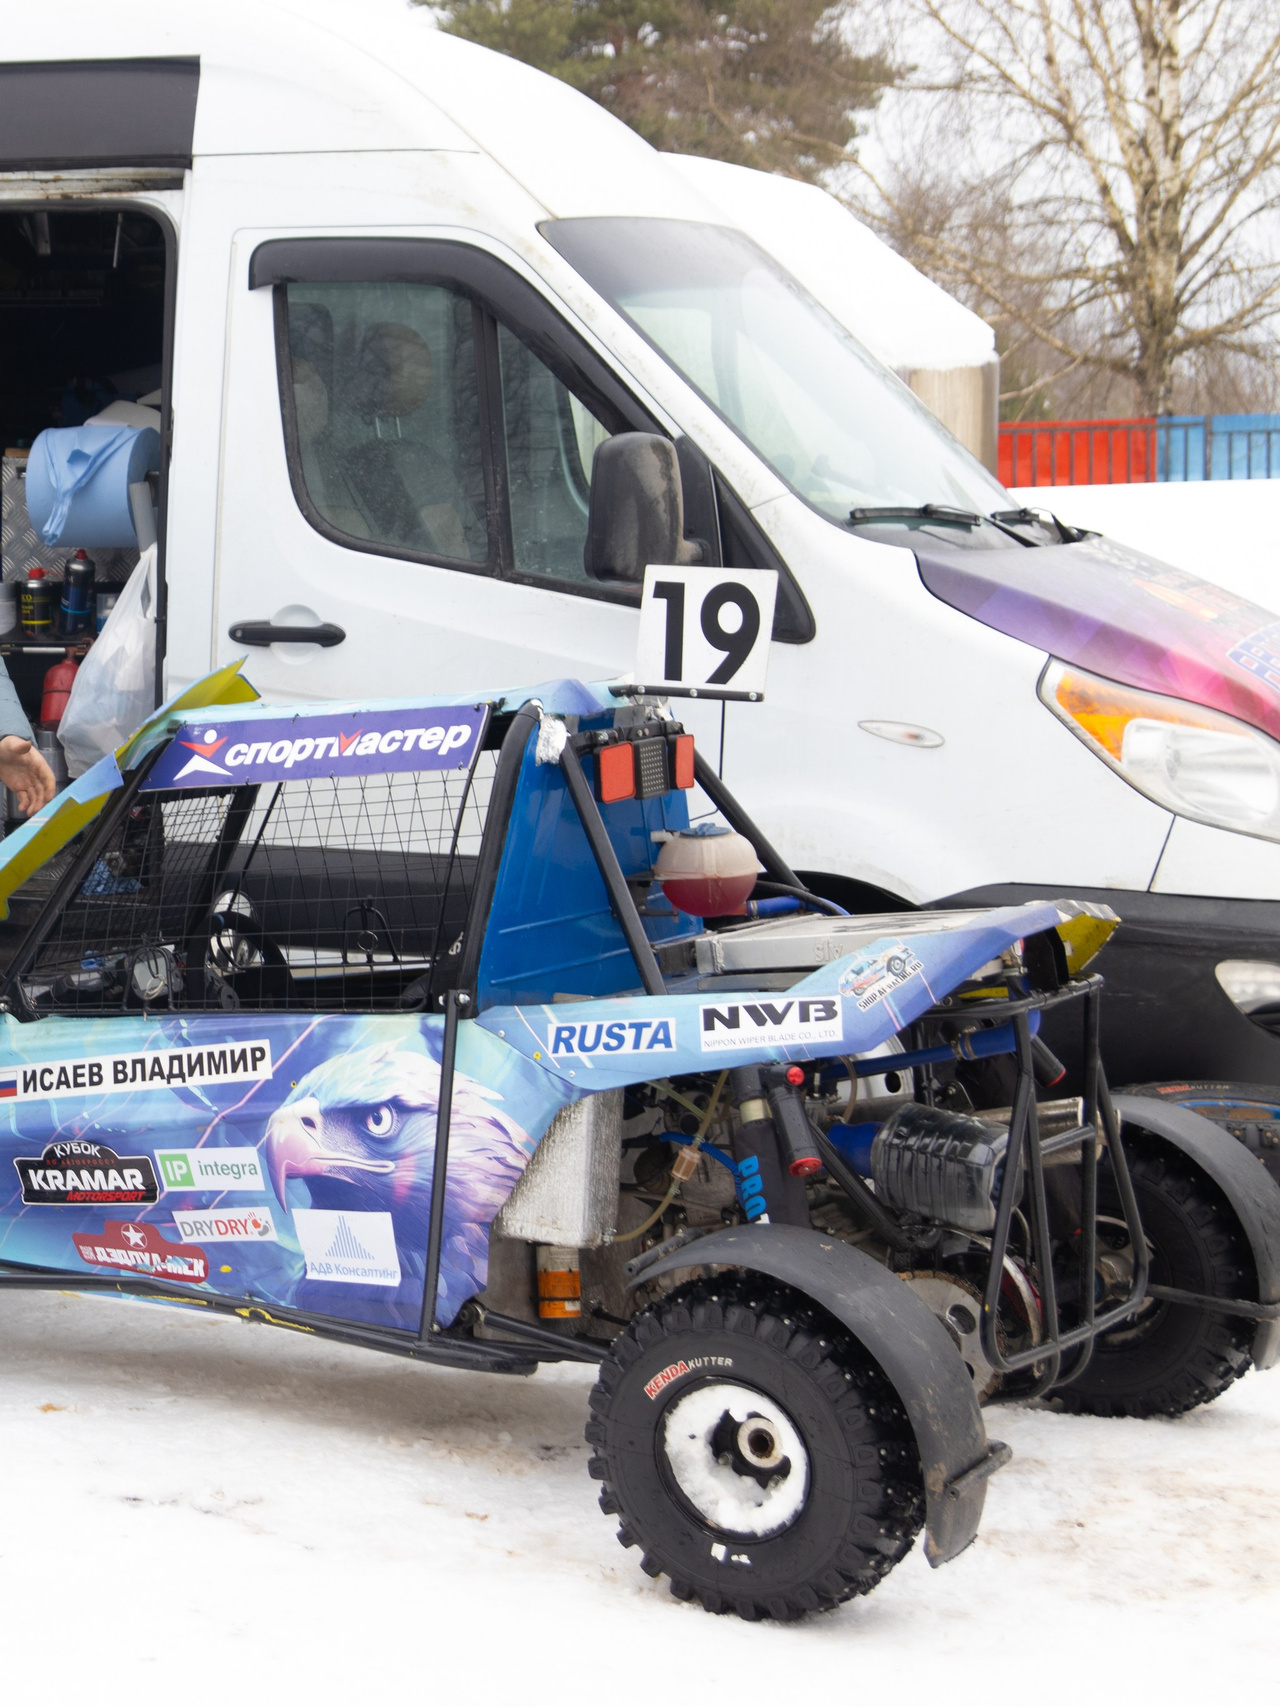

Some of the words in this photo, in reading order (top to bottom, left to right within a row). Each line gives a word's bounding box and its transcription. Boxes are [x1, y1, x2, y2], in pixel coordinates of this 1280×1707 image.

[653, 581, 760, 685] 19
[702, 999, 839, 1031] NWB
[551, 1020, 673, 1054] RUSTA
[704, 1039, 739, 1048] NIPPON
[738, 1035, 767, 1045] WIPER
[767, 1032, 797, 1043] BLADE
[22, 1062, 104, 1094] ИСАЕВ
[112, 1046, 266, 1085] ВЛАДИМИР
[53, 1142, 102, 1158] КУБОК
[27, 1168, 147, 1191] KRAMAR
[165, 1160, 189, 1182] IP
[197, 1160, 259, 1180] integra
[66, 1190, 147, 1202] MOTORSPORT
[310, 1260, 333, 1276] АДВ
[334, 1263, 398, 1280] Консалтинг
[644, 1360, 690, 1401] KENDA
[687, 1356, 733, 1370] KUTTER
